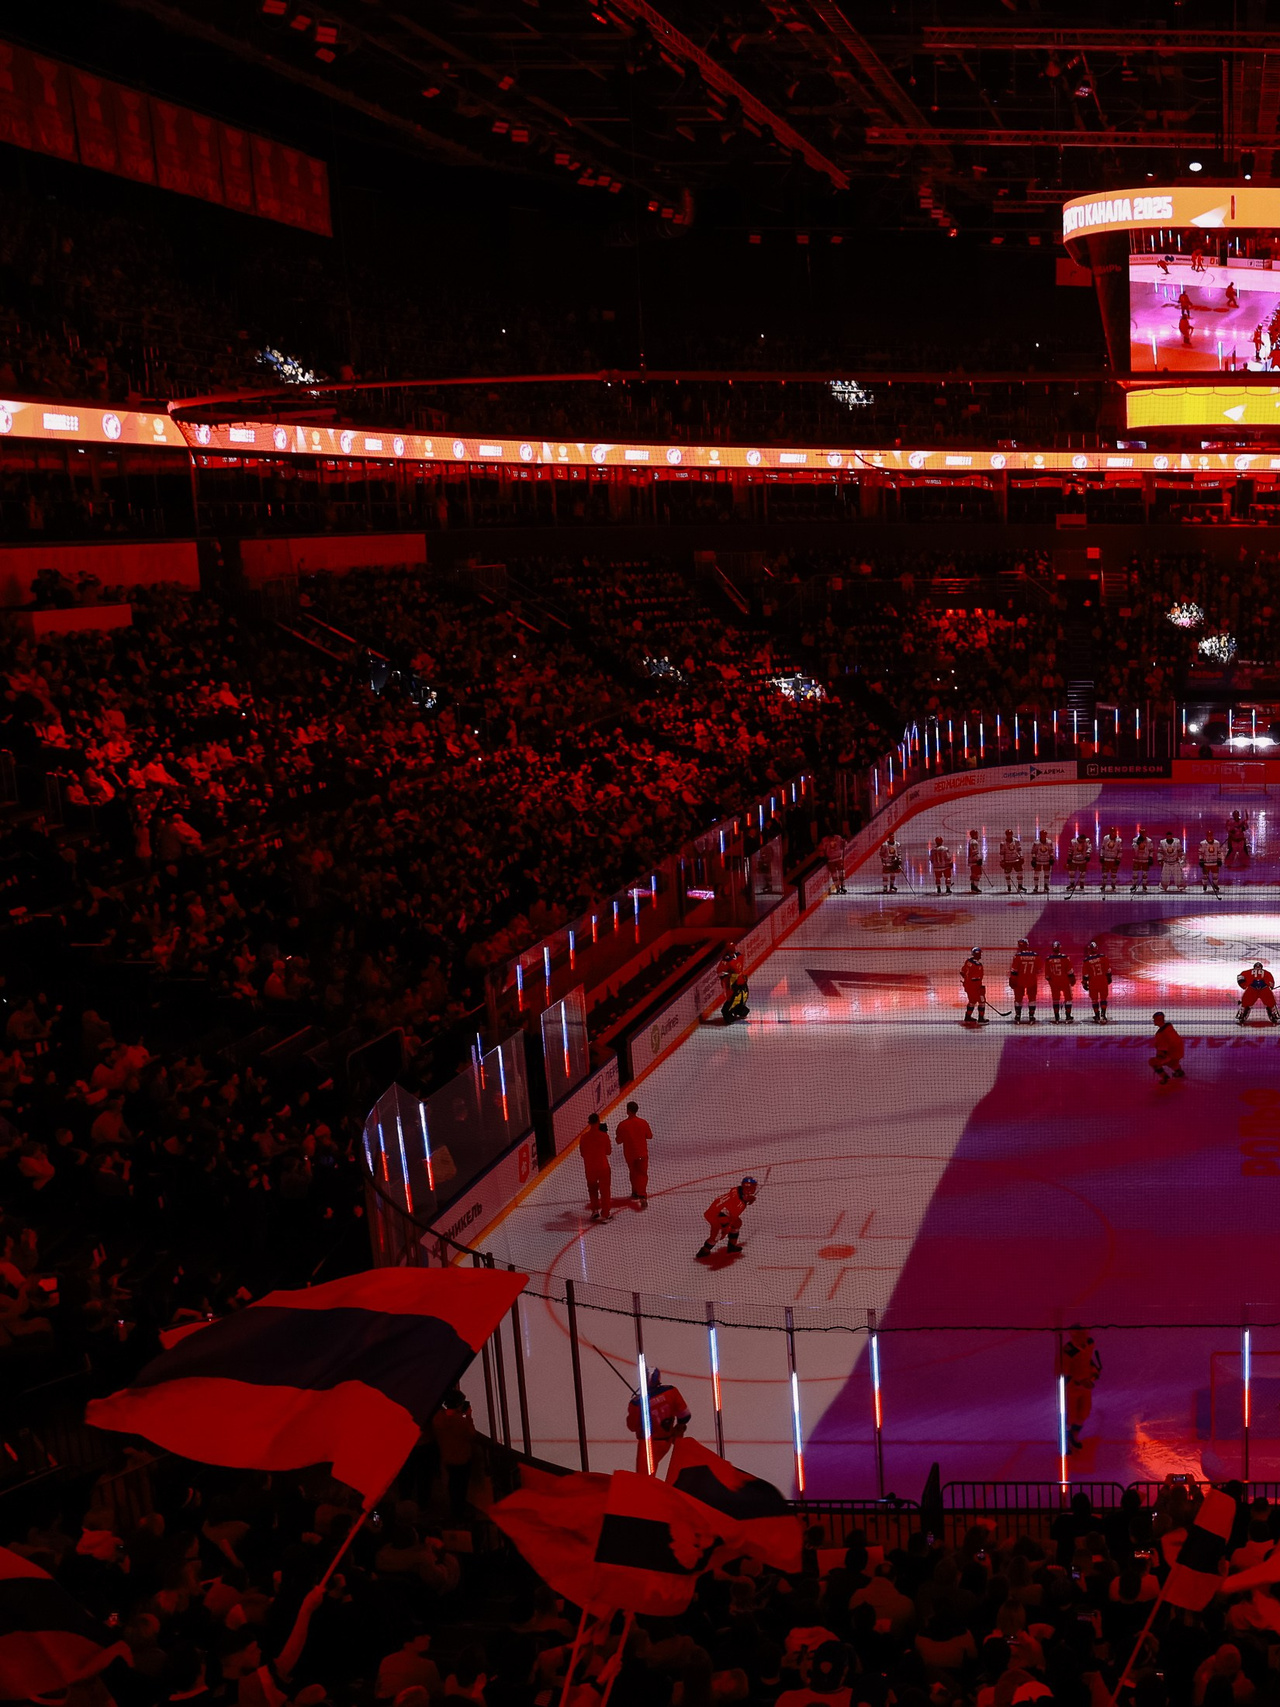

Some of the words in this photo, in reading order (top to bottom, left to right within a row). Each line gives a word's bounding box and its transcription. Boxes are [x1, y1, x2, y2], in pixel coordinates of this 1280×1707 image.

[1085, 198, 1133, 226] КАНАЛА
[1133, 196, 1172, 220] 2025
[934, 781, 946, 793] RED
[946, 775, 977, 790] MACHINE
[1021, 961, 1035, 975] 77
[1090, 963, 1103, 976] 13
